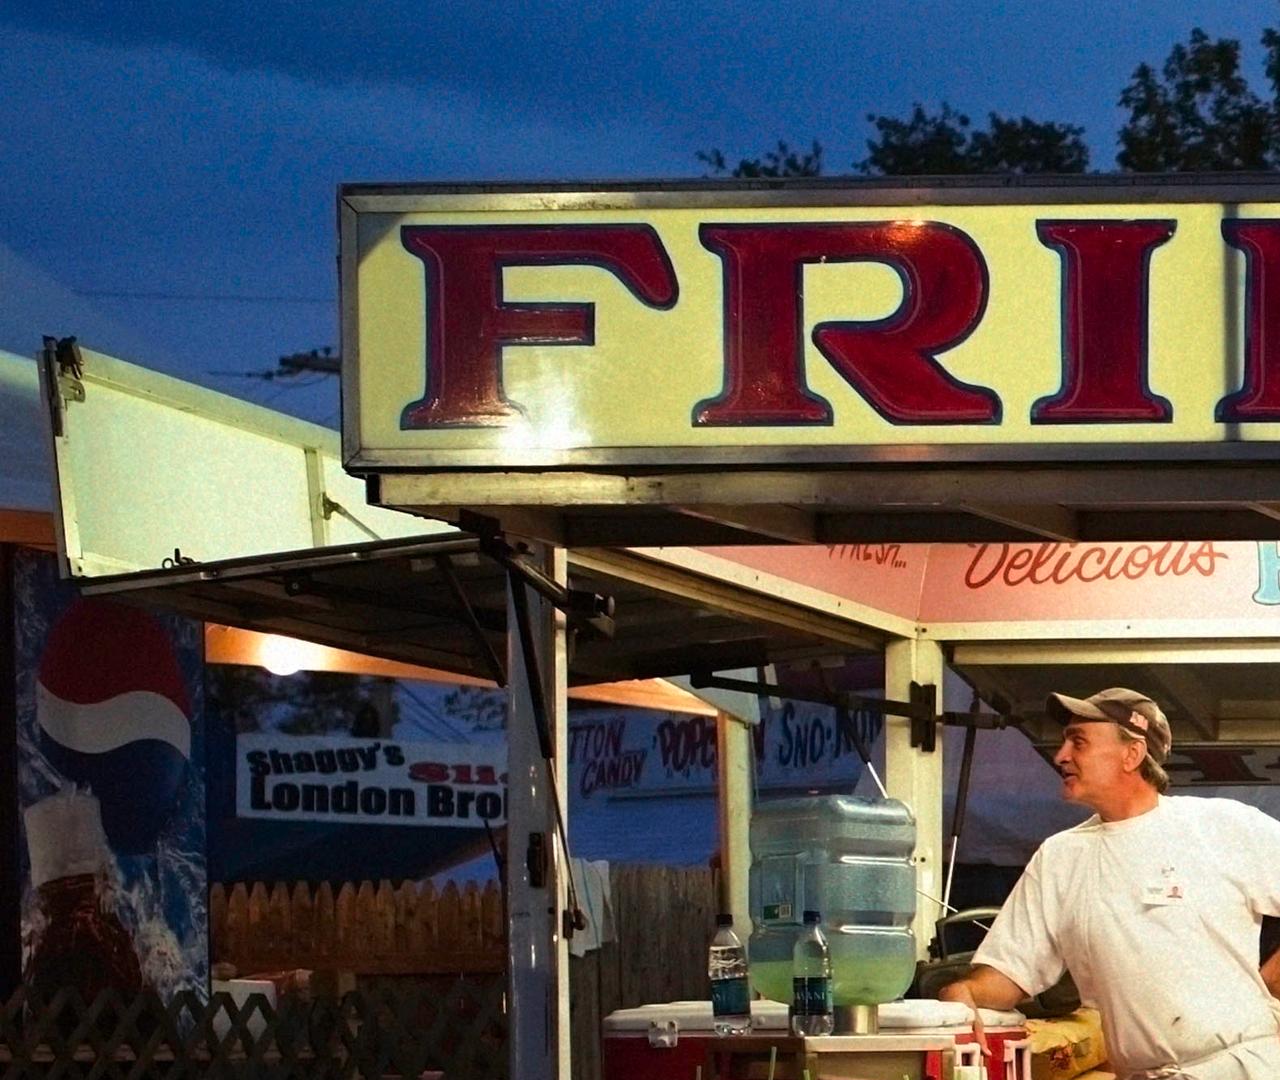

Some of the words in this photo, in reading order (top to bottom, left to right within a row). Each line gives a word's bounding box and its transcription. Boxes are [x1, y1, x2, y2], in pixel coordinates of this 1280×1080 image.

[964, 541, 1228, 589] Delicious
[246, 742, 405, 776] Shaggy's
[250, 773, 415, 817] London
